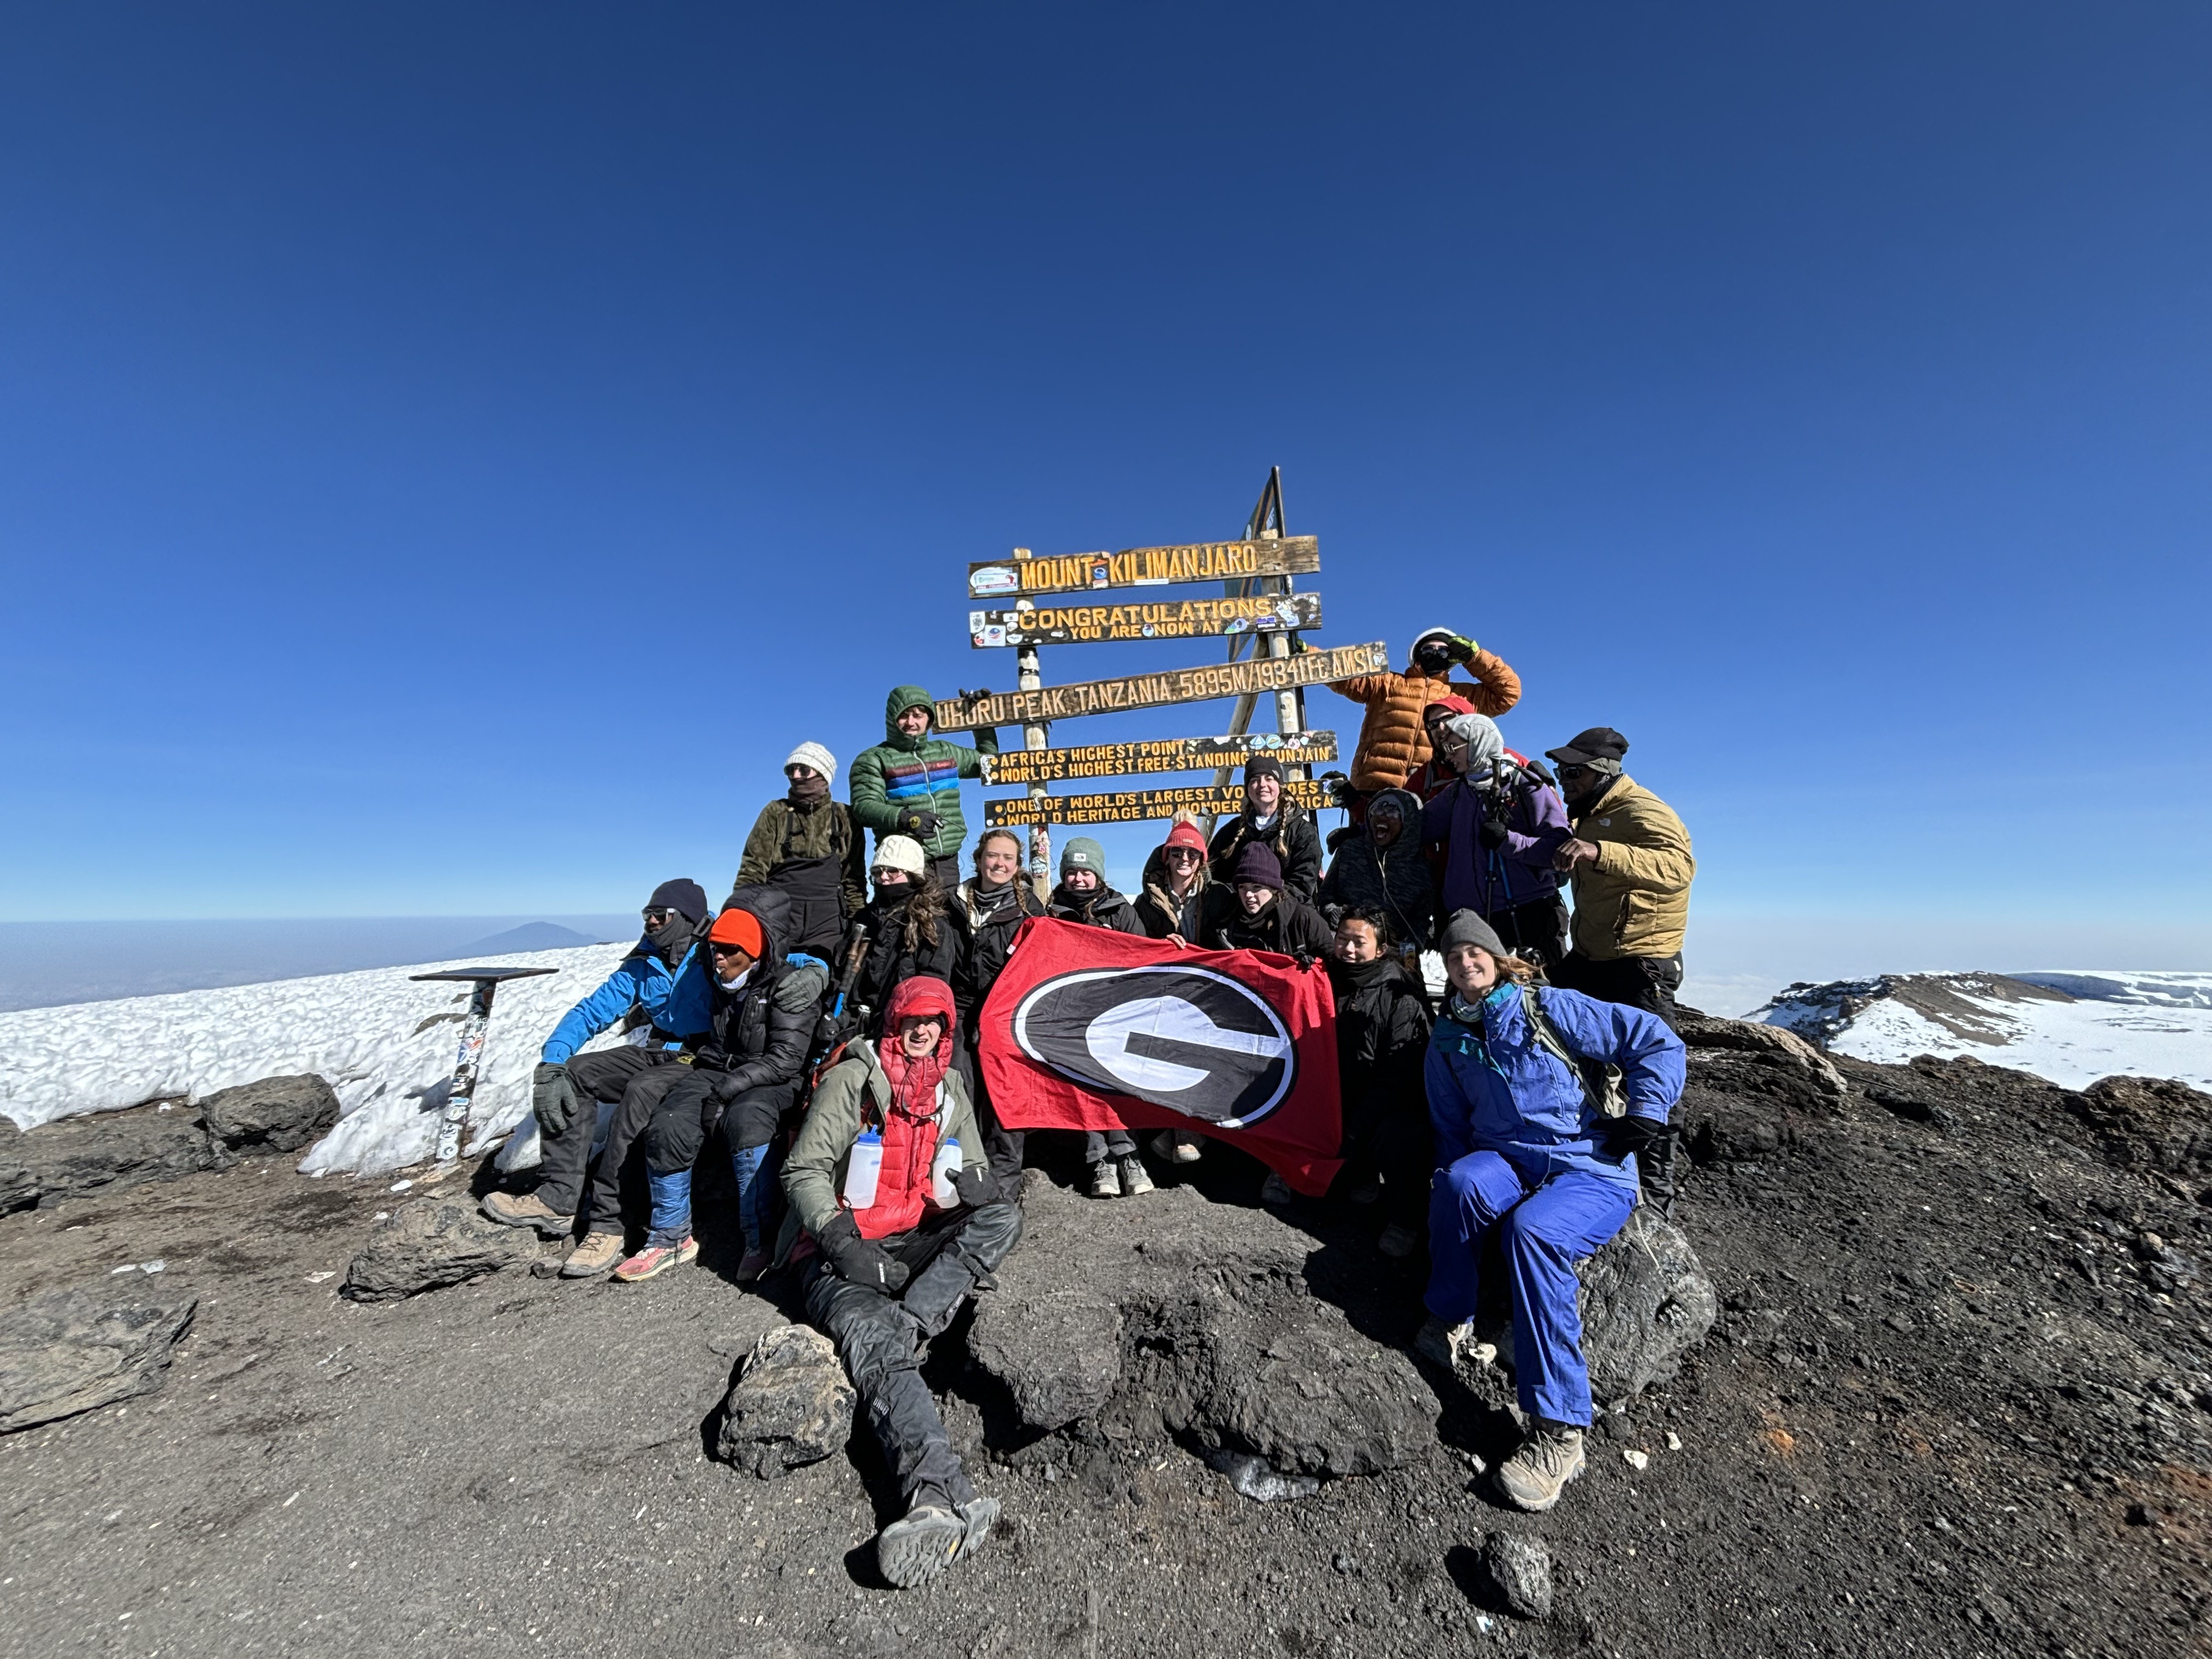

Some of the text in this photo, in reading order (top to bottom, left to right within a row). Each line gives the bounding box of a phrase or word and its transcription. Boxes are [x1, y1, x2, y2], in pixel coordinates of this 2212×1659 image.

[1020, 545, 1257, 590] MOUNT KILIMANJARO
[1019, 598, 1272, 630] CONGRATULATIONS
[1070, 620, 1221, 640] YOU ARE NOW AT
[1333, 647, 1381, 677] AMSL
[1000, 740, 1185, 768] AFRICA'S HIGHEST POINT
[1000, 764, 1064, 783] WORLD'S
[1069, 759, 1134, 777] HIGHEST
[1006, 782, 1318, 813] ONE OF WORLD'S LARGEST VOOES
[1067, 806, 1141, 823] HERITAGE
[1147, 804, 1173, 817] AND
[1295, 794, 1333, 809] RICA
